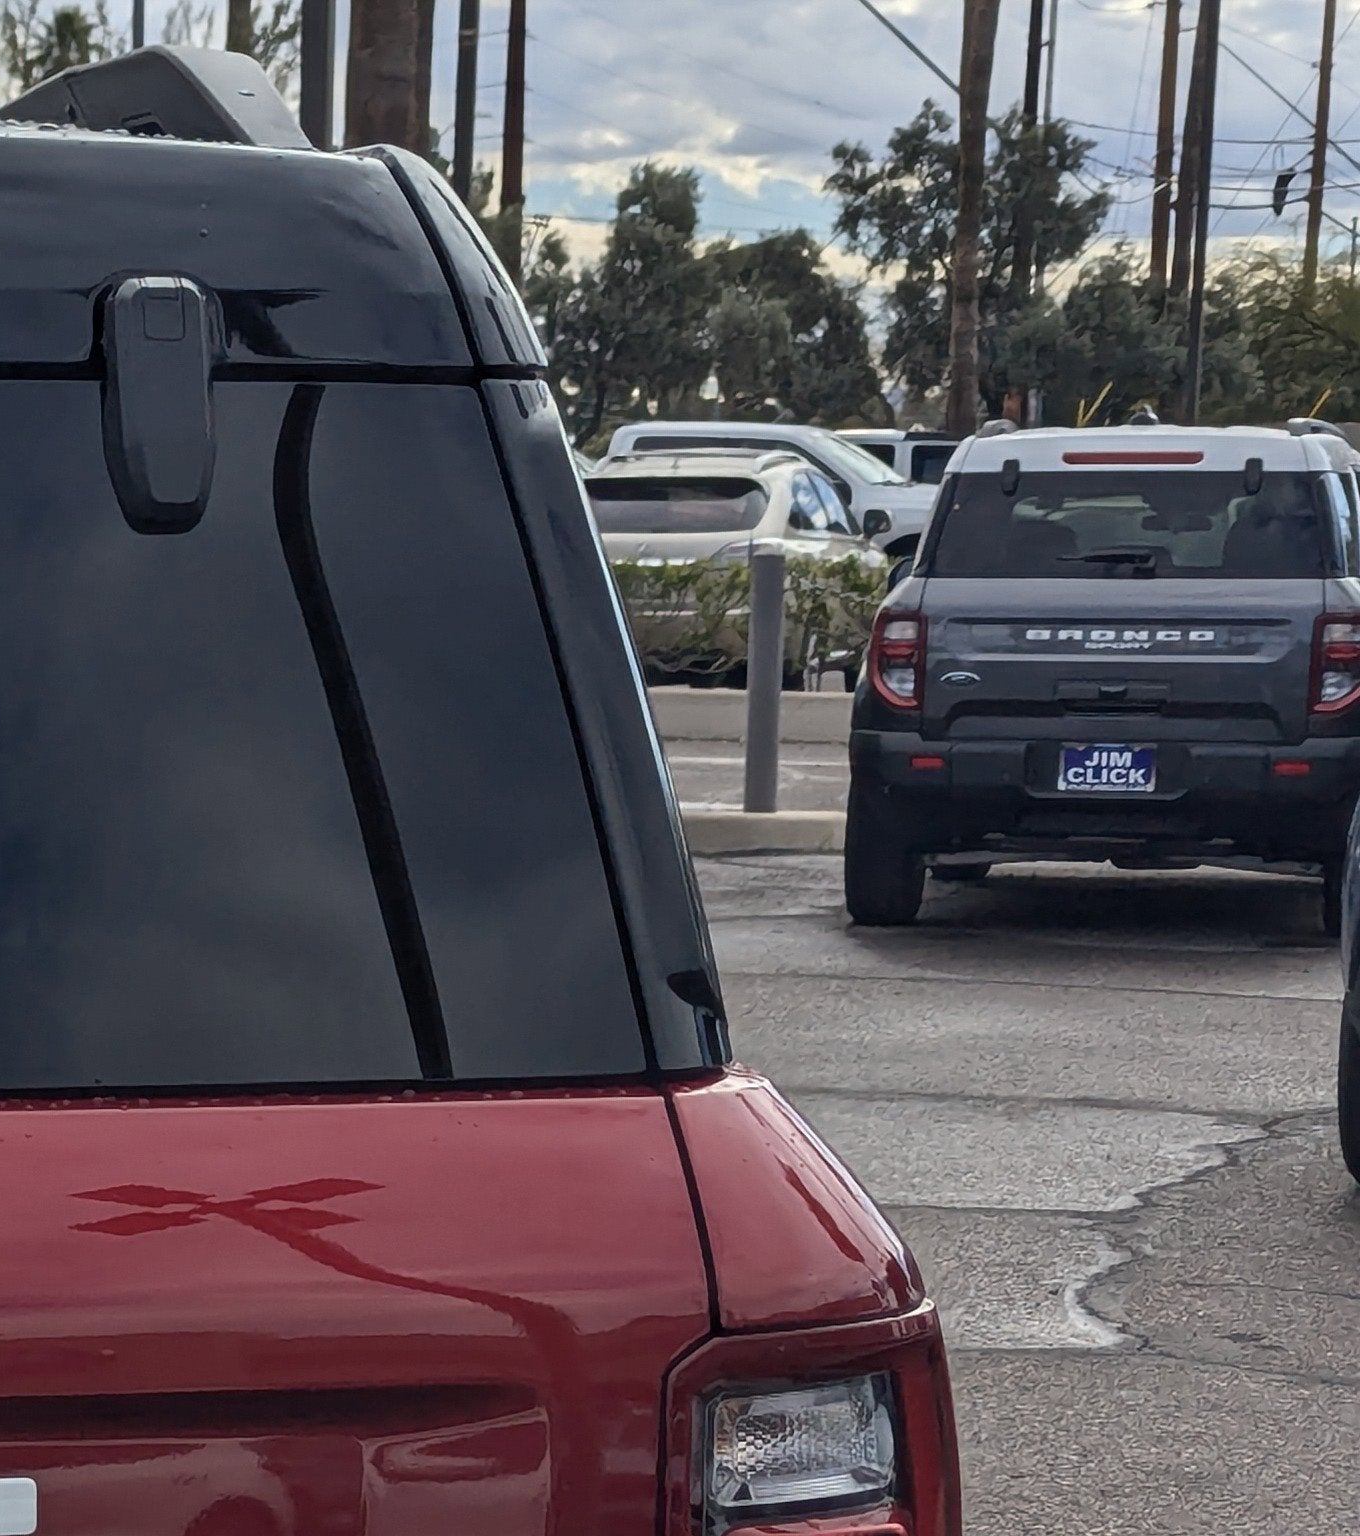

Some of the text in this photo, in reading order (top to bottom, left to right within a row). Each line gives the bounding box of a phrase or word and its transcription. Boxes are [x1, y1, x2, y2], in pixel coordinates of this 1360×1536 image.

[1025, 629, 1216, 641] BRONCO
[1084, 751, 1133, 768] JIM
[1067, 767, 1147, 785] CLICK
